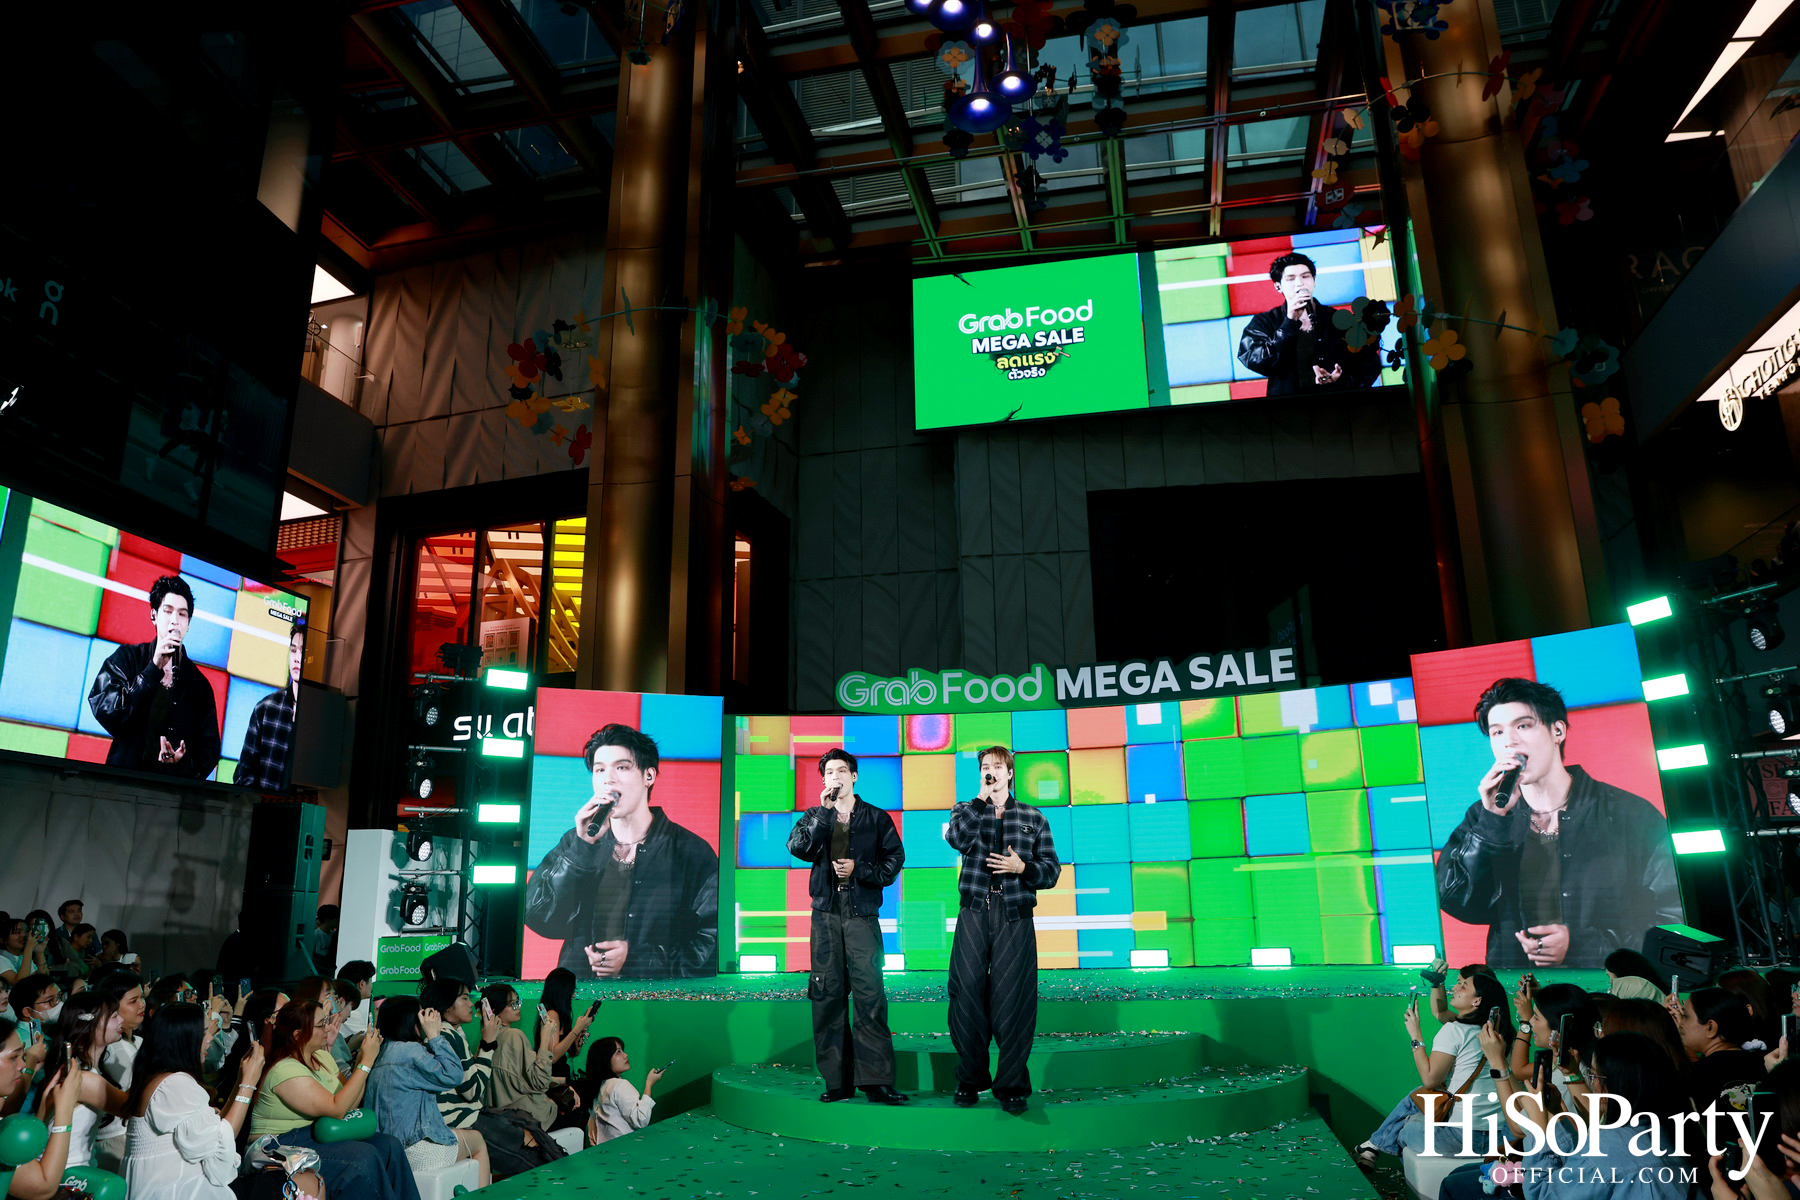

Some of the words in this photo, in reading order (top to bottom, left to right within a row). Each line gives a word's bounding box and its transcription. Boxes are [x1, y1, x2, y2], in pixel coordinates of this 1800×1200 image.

[958, 299, 1093, 334] GrabFood
[972, 333, 1031, 354] MEGA
[1034, 327, 1085, 347] SALE
[996, 352, 1056, 369] ลดแรง
[263, 595, 302, 617] GrabFood
[839, 666, 1043, 706] GrabFood
[1057, 660, 1181, 700] MEGA
[1189, 647, 1298, 691] SALE
[380, 943, 421, 953] GrabFood
